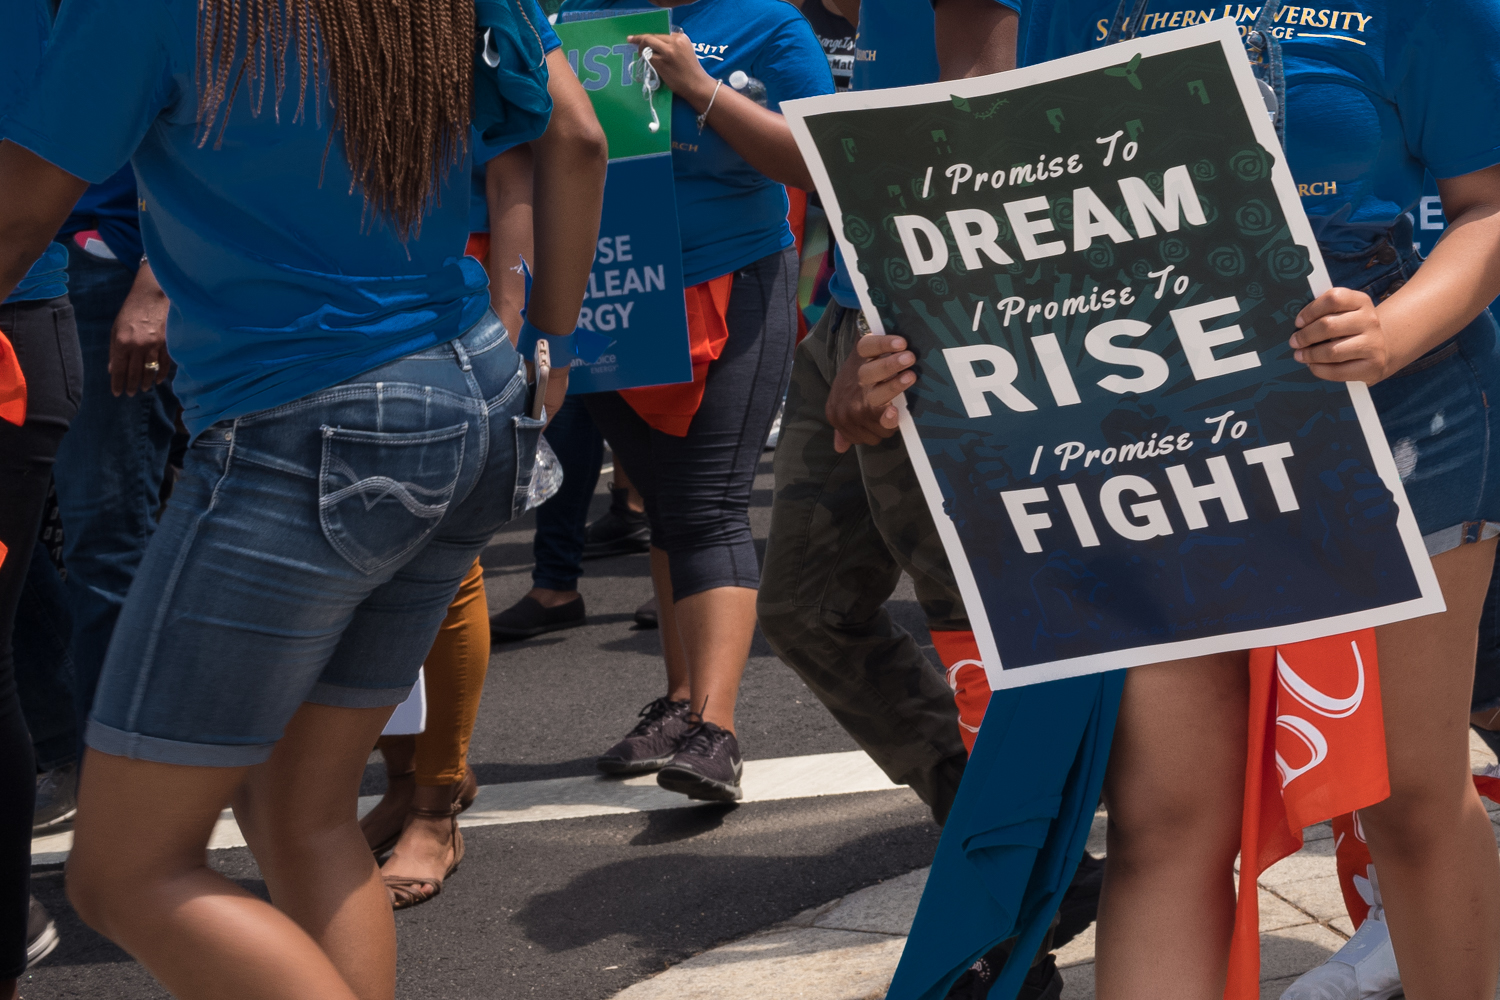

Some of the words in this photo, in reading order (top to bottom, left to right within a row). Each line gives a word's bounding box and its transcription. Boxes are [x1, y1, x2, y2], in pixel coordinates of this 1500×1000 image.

[921, 165, 933, 198] I
[945, 153, 1082, 196] Promise
[1095, 130, 1139, 167] To
[893, 165, 1207, 276] DREAM
[971, 300, 984, 332] I
[996, 285, 1136, 328] Promise
[1147, 264, 1190, 301] To
[942, 295, 1262, 419] RISE
[1029, 445, 1043, 476] I
[1053, 431, 1194, 474] Promise
[1205, 410, 1248, 447] To
[1000, 442, 1301, 554] FIGHT
